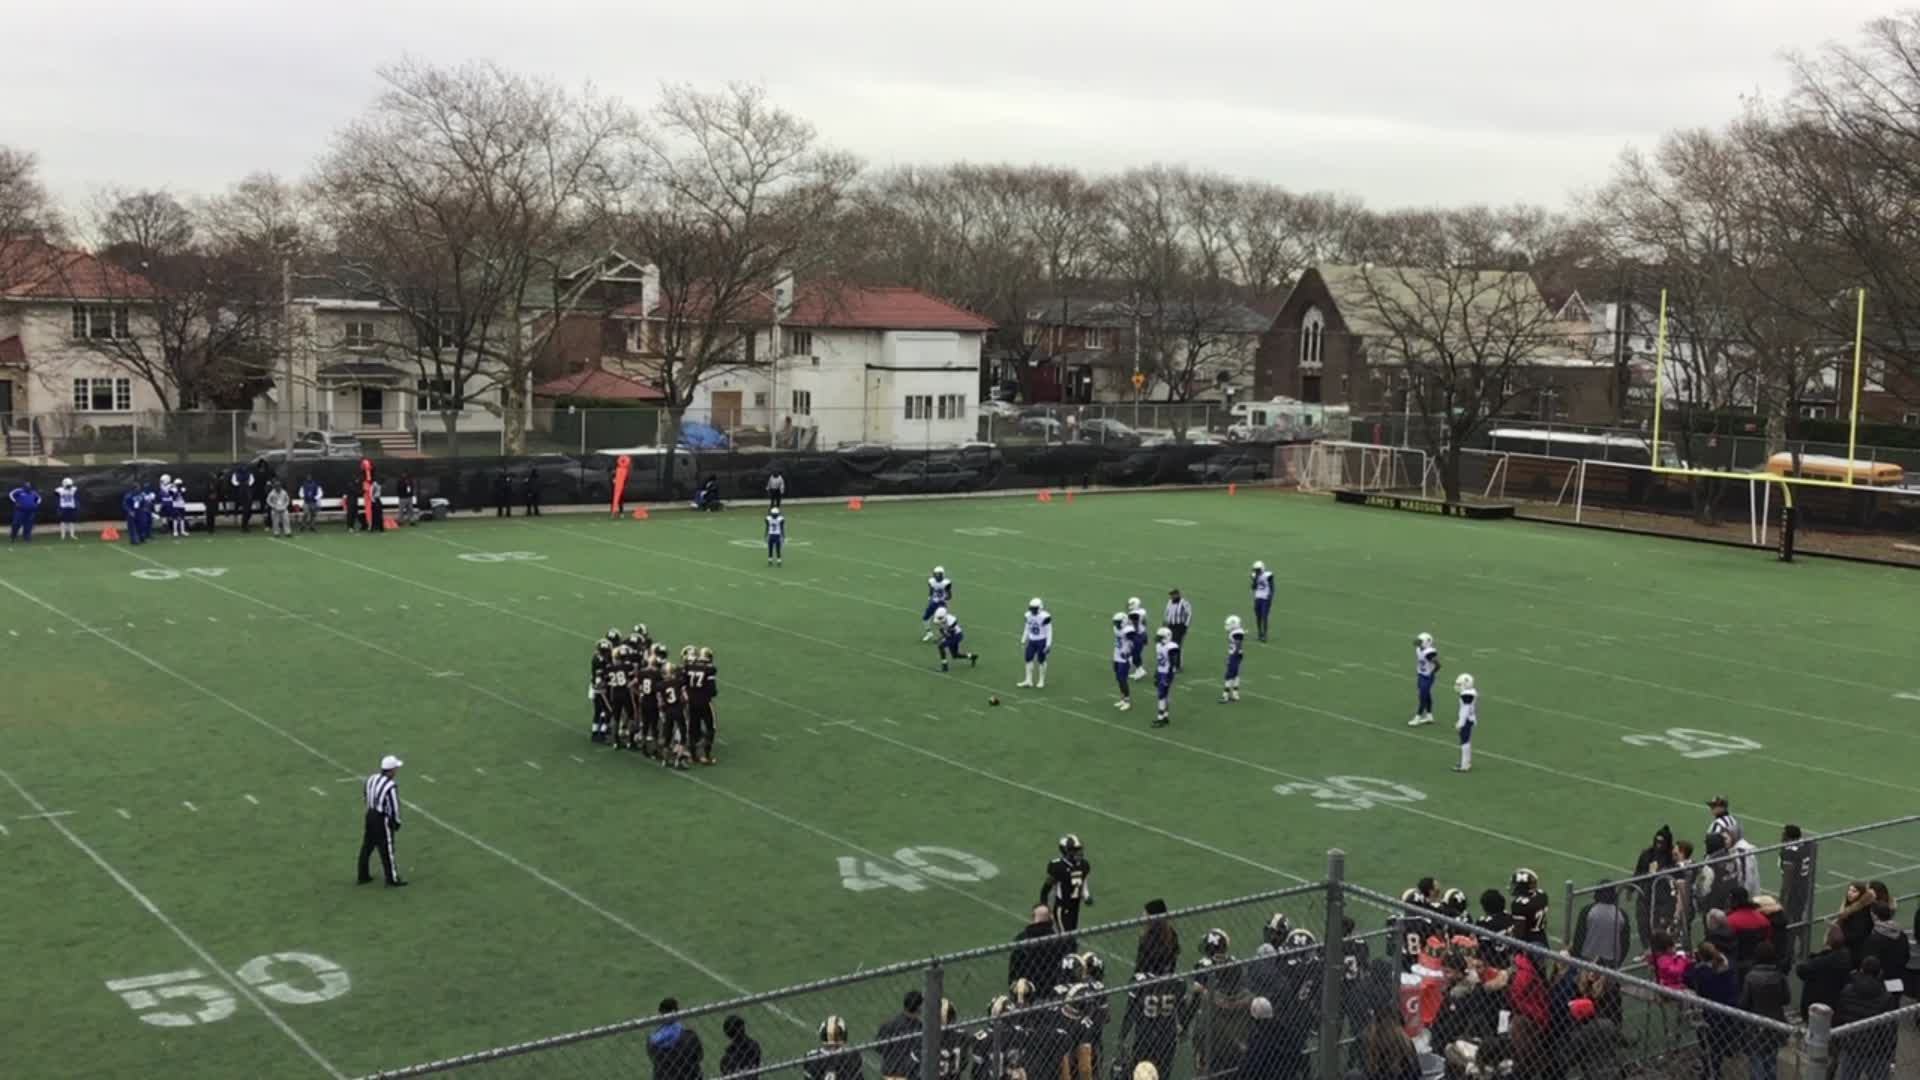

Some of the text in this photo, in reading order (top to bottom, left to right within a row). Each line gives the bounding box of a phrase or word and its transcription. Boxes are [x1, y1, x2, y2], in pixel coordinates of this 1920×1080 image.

[687, 670, 705, 688] 77
[665, 687, 677, 704] 3
[1272, 775, 1427, 811] 30
[836, 845, 1000, 892] 40
[1070, 878, 1083, 899] 7
[104, 951, 351, 1027] 50
[1143, 994, 1176, 1018] 65
